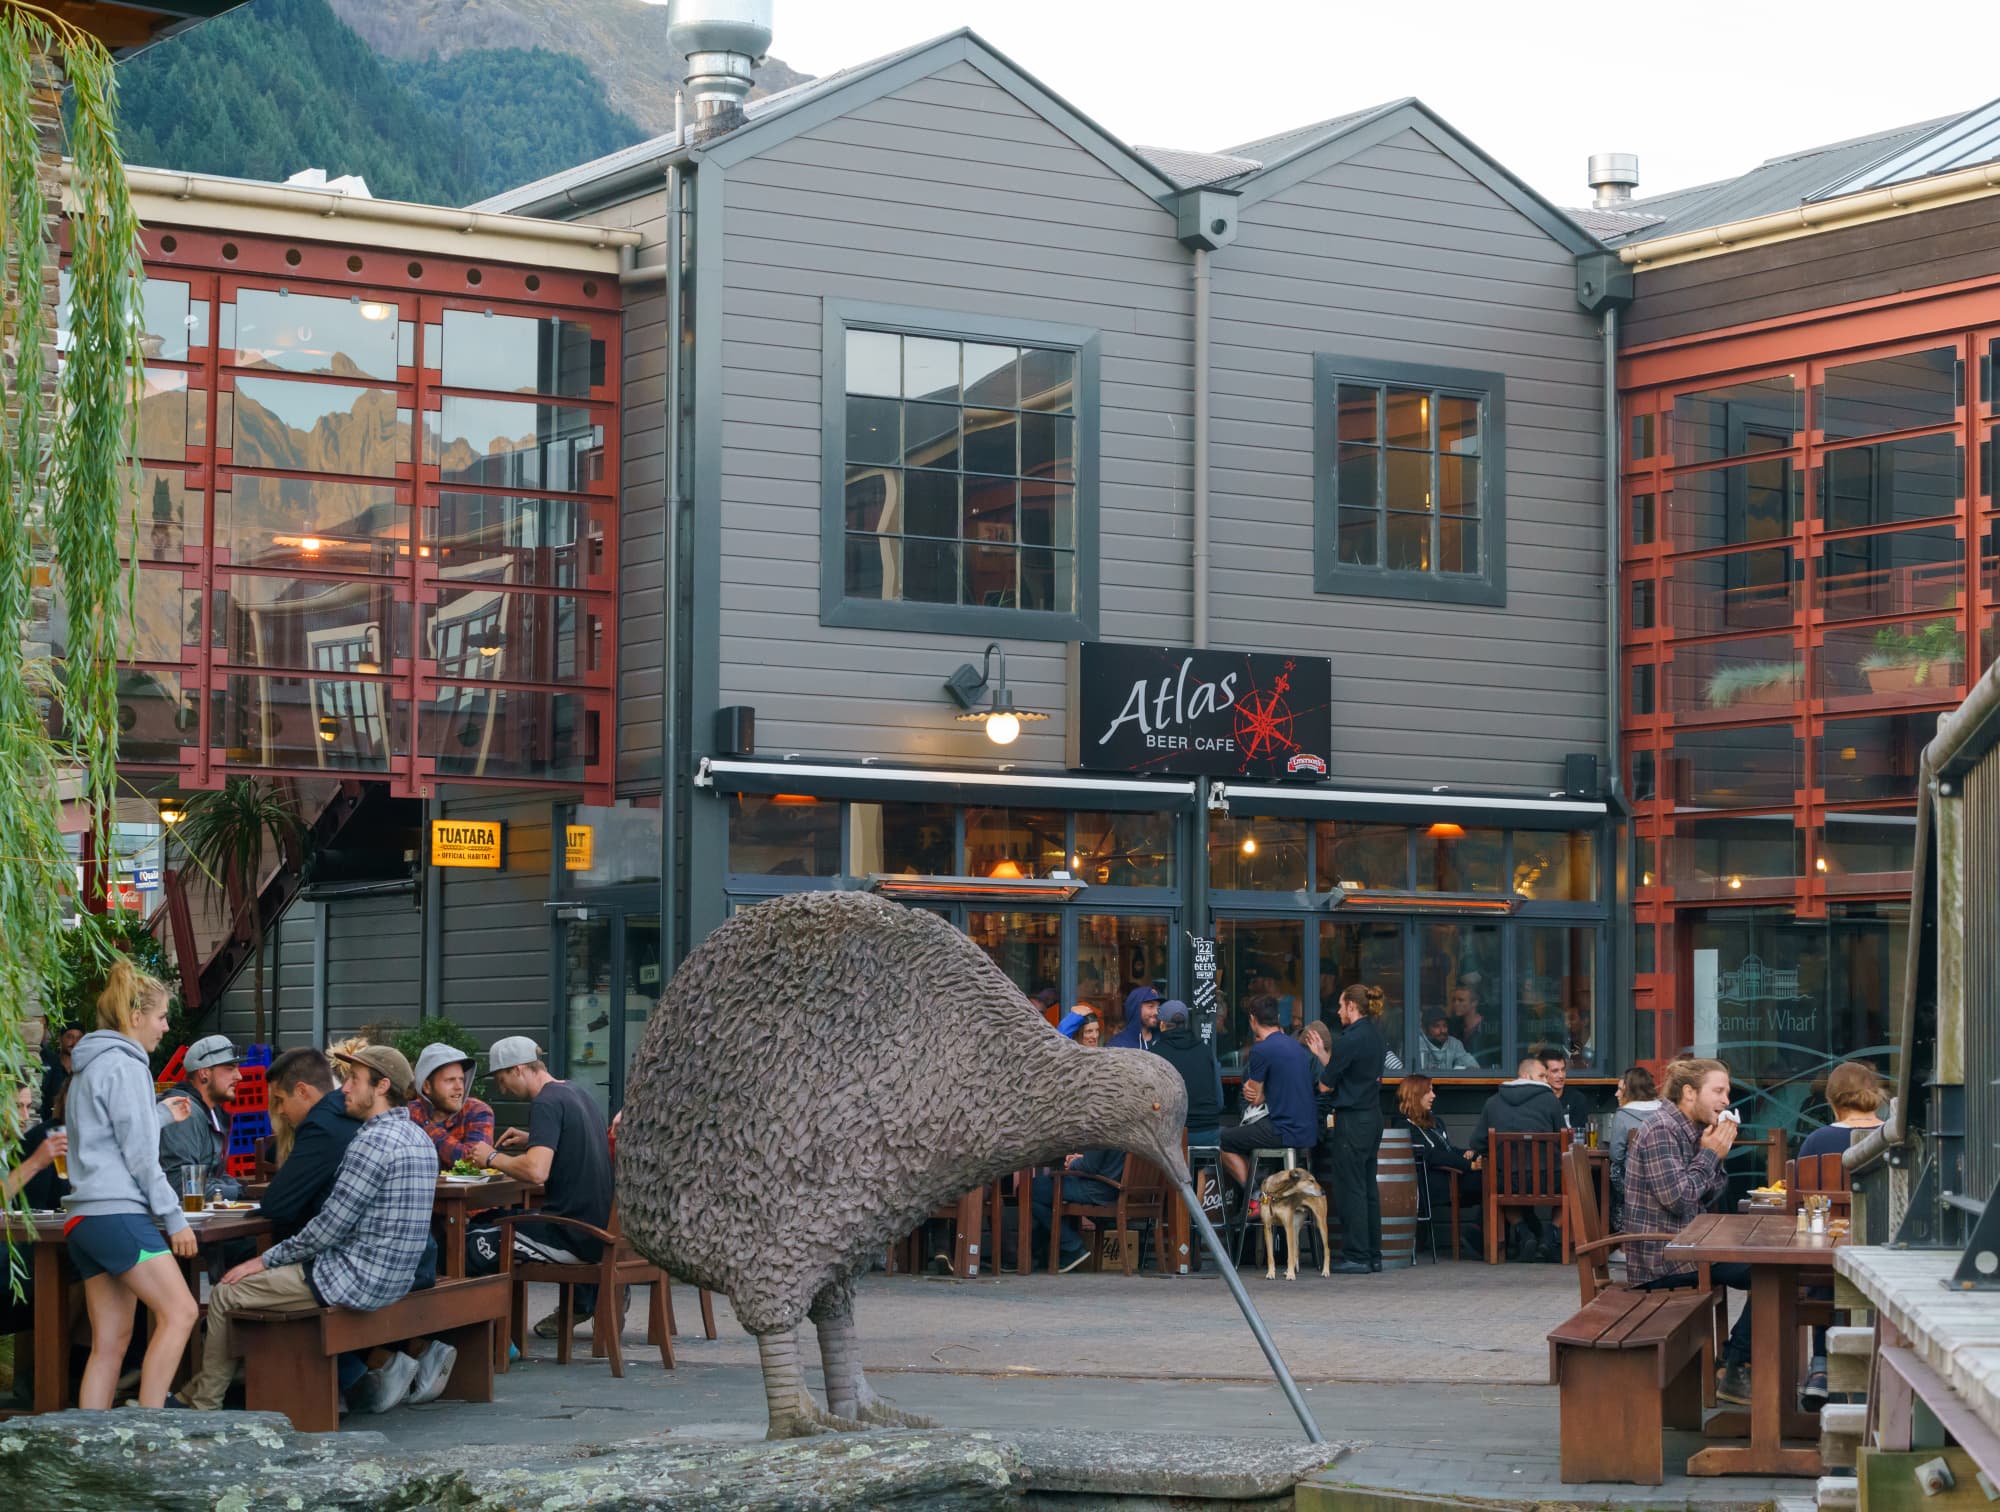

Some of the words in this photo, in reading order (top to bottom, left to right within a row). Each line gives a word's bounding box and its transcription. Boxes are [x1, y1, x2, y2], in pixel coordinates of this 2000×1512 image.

[1098, 656, 1237, 745] Atlas
[1146, 734, 1189, 750] BEER
[1195, 737, 1235, 752] CAFE
[438, 827, 495, 846] TUATARA
[441, 852, 466, 860] OFFICIAL
[467, 853, 491, 861] HABITAT
[1199, 943, 1211, 953] 22
[1195, 954, 1215, 963] CRAFT
[1194, 963, 1217, 971] BEERS
[1767, 1008, 1817, 1032] Wharf
